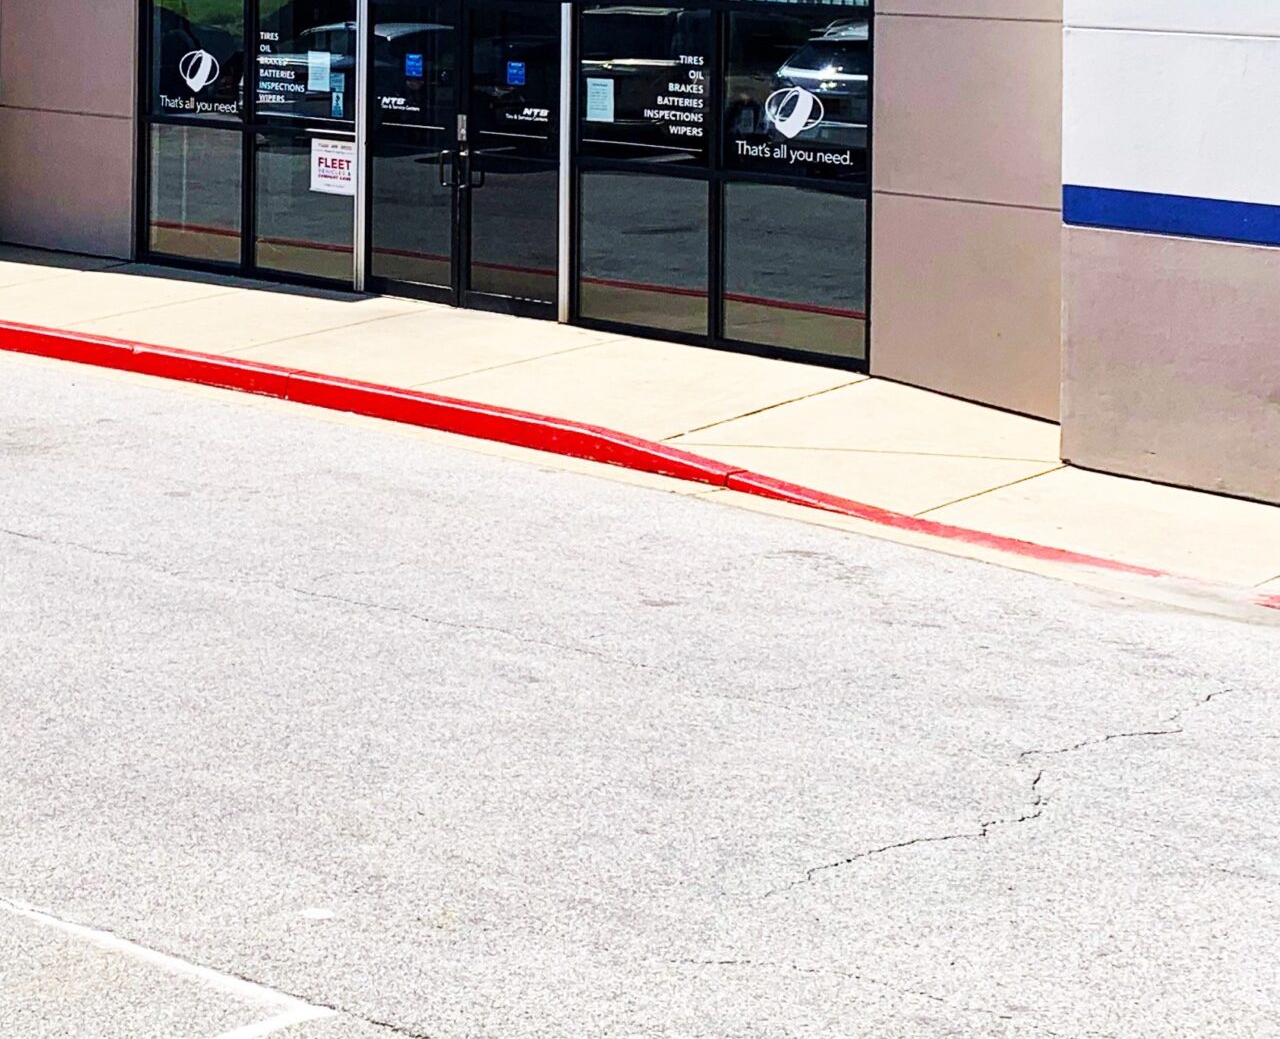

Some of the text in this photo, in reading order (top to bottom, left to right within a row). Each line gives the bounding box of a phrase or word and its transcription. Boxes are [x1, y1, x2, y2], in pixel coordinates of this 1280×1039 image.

[260, 32, 279, 41] TIRES
[259, 44, 272, 53] OIL
[679, 54, 704, 66] TIRES
[260, 69, 295, 79] BATTERIES
[688, 69, 704, 80] OIL
[259, 81, 305, 93] INSPECTIONS
[668, 82, 704, 94] BRAKES
[160, 94, 239, 114] That's all you need.
[258, 94, 285, 103] WIPERS
[381, 96, 406, 105] NTB
[657, 95, 704, 109] BATTERIES
[523, 107, 549, 116] NTB
[643, 108, 704, 122] INSPECTIONS
[669, 125, 704, 137] WIPERS
[736, 140, 853, 165] That's all you need.
[318, 156, 352, 170] FLEET
